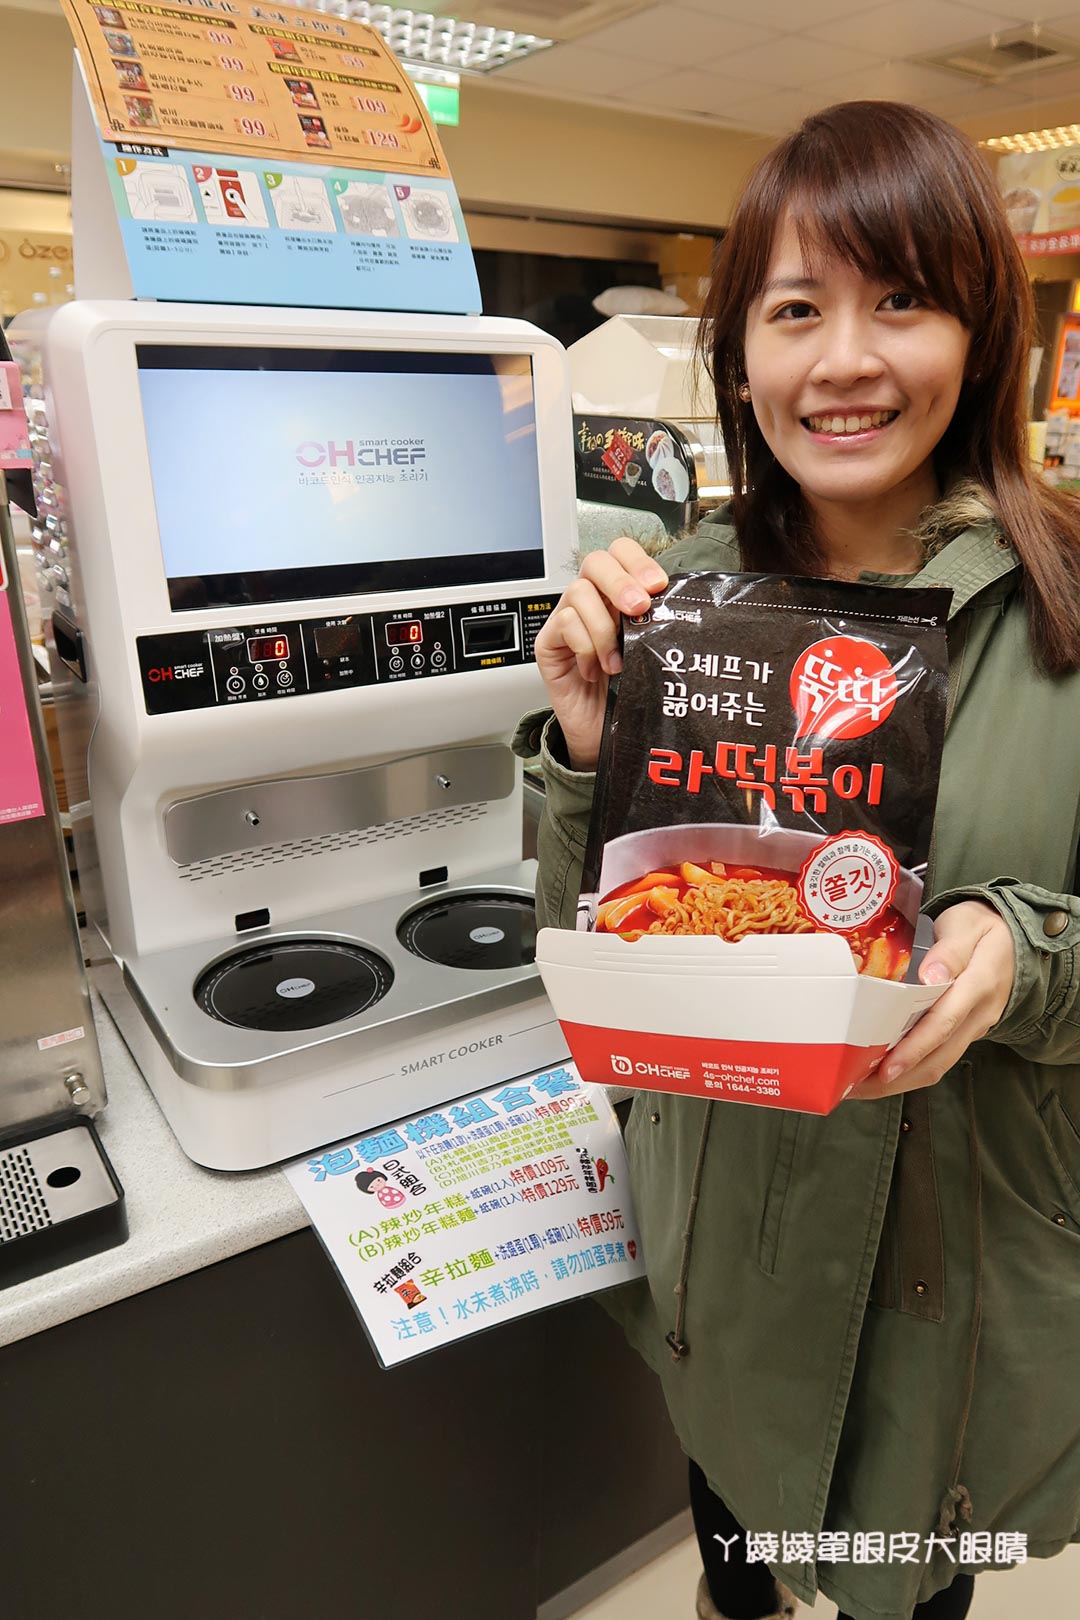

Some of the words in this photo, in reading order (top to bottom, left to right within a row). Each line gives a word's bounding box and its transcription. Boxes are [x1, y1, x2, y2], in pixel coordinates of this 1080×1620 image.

[208, 30, 234, 46] 99
[220, 55, 245, 72] 99
[231, 85, 256, 102] 99
[357, 97, 388, 114] 109
[241, 118, 266, 137] 99
[369, 129, 400, 148] 129
[119, 159, 127, 173] 1
[195, 166, 205, 180] 2
[266, 174, 276, 186] 3
[334, 181, 342, 192] 4
[359, 438, 388, 446] smart
[390, 437, 425, 446] cooker
[355, 473, 396, 485] 인공지능
[399, 472, 429, 482] 조리기
[424, 611, 445, 620] 加熱盤2
[214, 632, 245, 643] 加熱盤1
[410, 625, 419, 640] 0
[275, 640, 285, 656] 0
[661, 648, 774, 684] 오셰프가
[662, 681, 766, 727] 끓여주는
[647, 740, 884, 814] 라떡볶이
[825, 866, 872, 903] 쫄깃
[400, 1052, 445, 1077] SMART
[448, 1034, 504, 1061] COOKER
[705, 1080, 723, 1090] 문의
[727, 1083, 781, 1097] 1644-3380
[307, 1068, 580, 1183] 泡麵機組合餐
[373, 1252, 422, 1294] 辛拉麵組合
